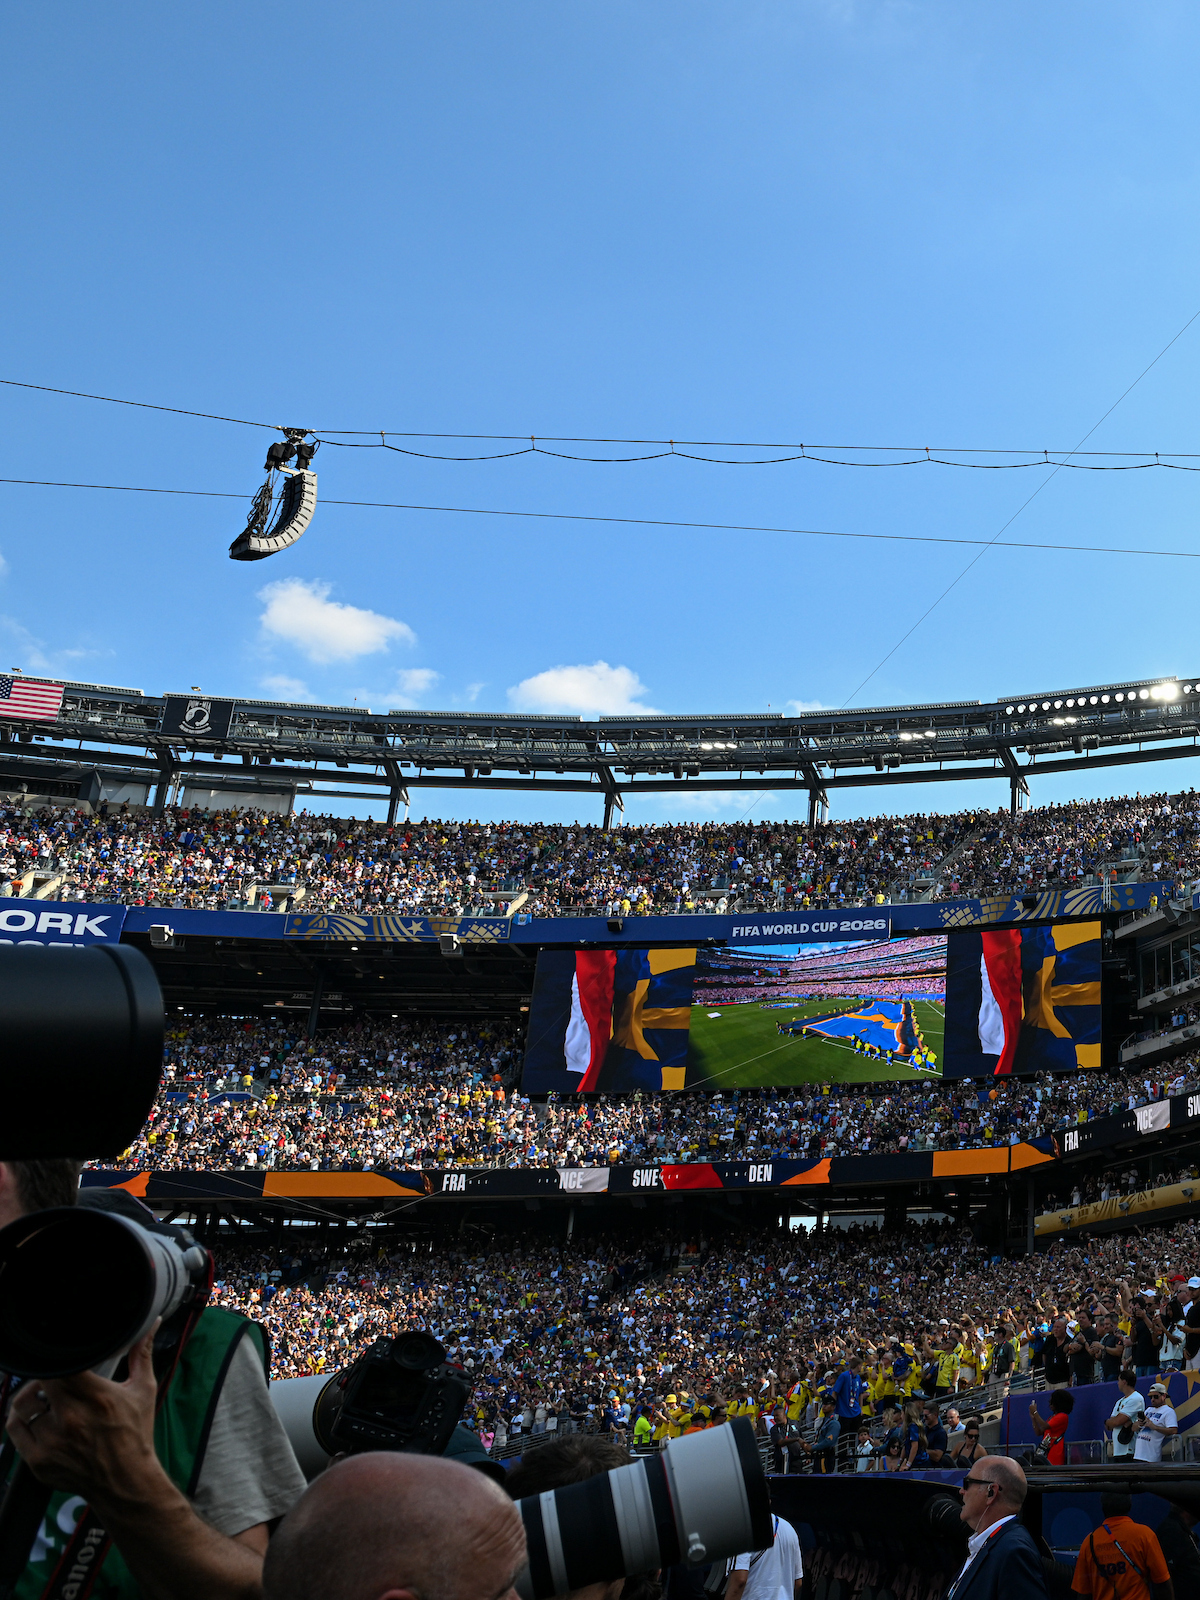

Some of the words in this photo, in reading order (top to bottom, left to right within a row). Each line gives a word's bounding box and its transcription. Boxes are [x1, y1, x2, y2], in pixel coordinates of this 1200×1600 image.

[732, 926, 760, 937] FIFA
[762, 922, 808, 936] WORLD
[811, 921, 838, 933] CUP
[839, 918, 887, 932] 2026
[1136, 1108, 1154, 1131] NCE
[1064, 1130, 1079, 1152] FRA
[442, 1173, 466, 1191] FRA
[558, 1171, 584, 1189] NCE
[632, 1168, 659, 1187] SWE
[748, 1164, 773, 1182] DEN
[60, 1527, 106, 1600] anon
